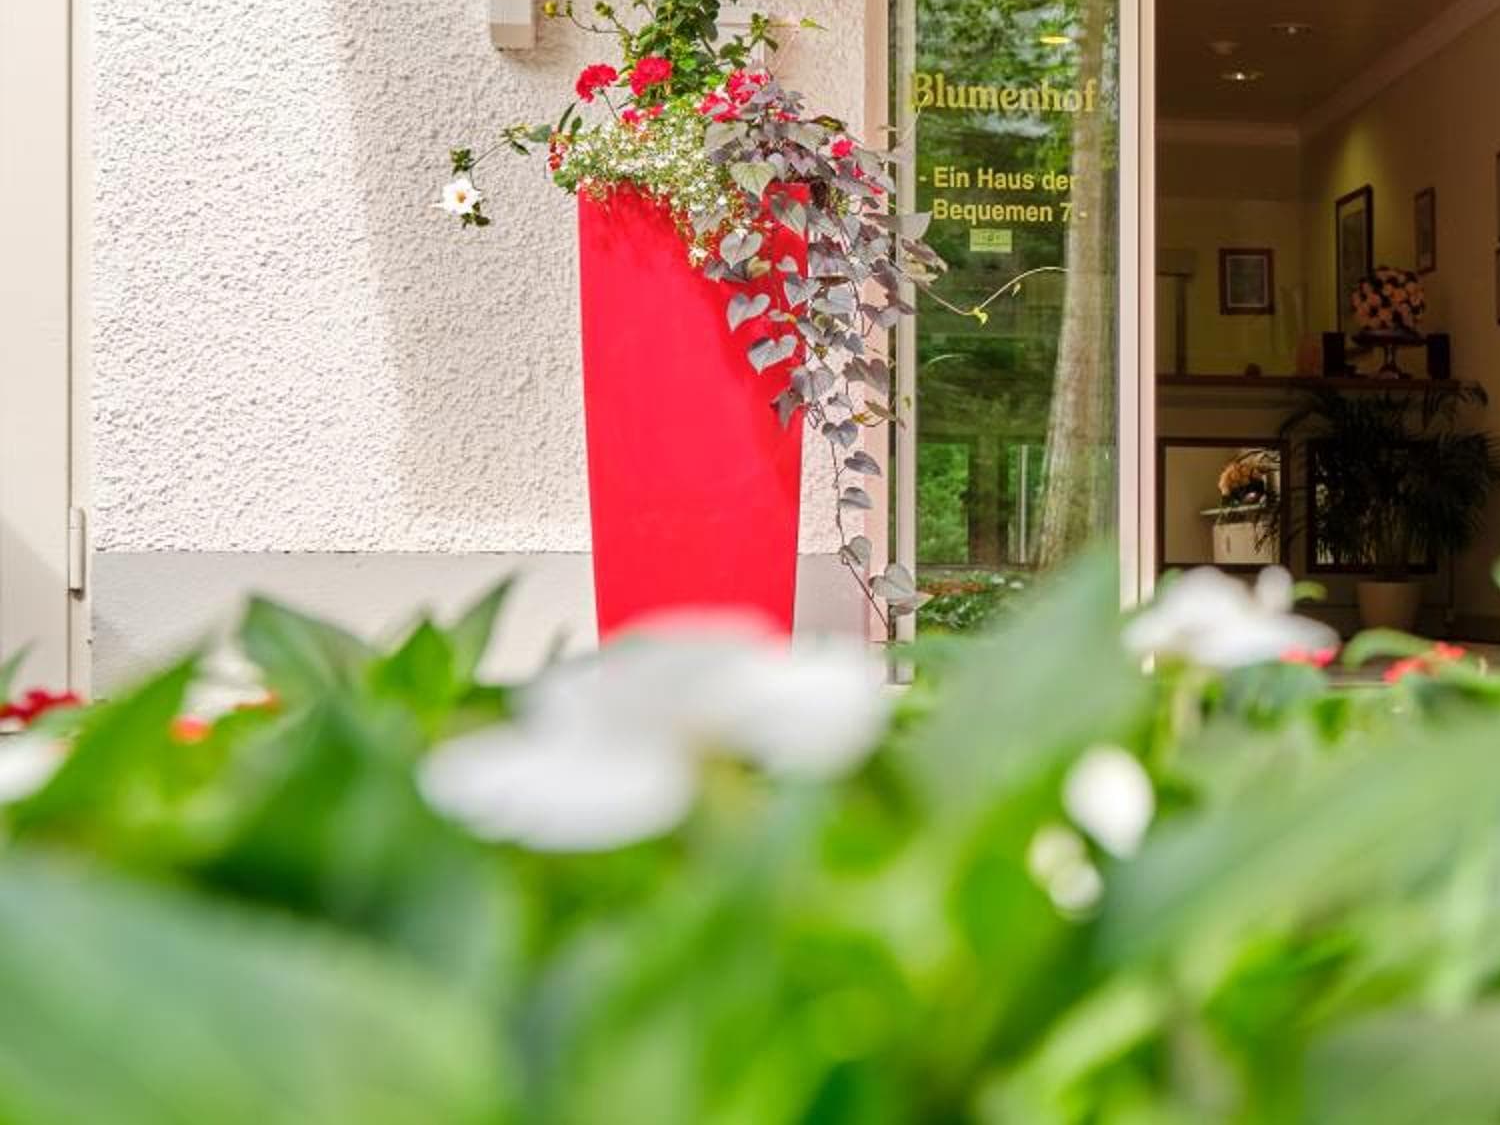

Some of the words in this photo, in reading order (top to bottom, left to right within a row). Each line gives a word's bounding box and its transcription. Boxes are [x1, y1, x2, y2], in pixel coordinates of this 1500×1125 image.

[911, 72, 1097, 112] Blumenhof
[933, 166, 970, 188] Ein
[977, 168, 1036, 190] Haus
[933, 199, 1053, 225] Bequemen
